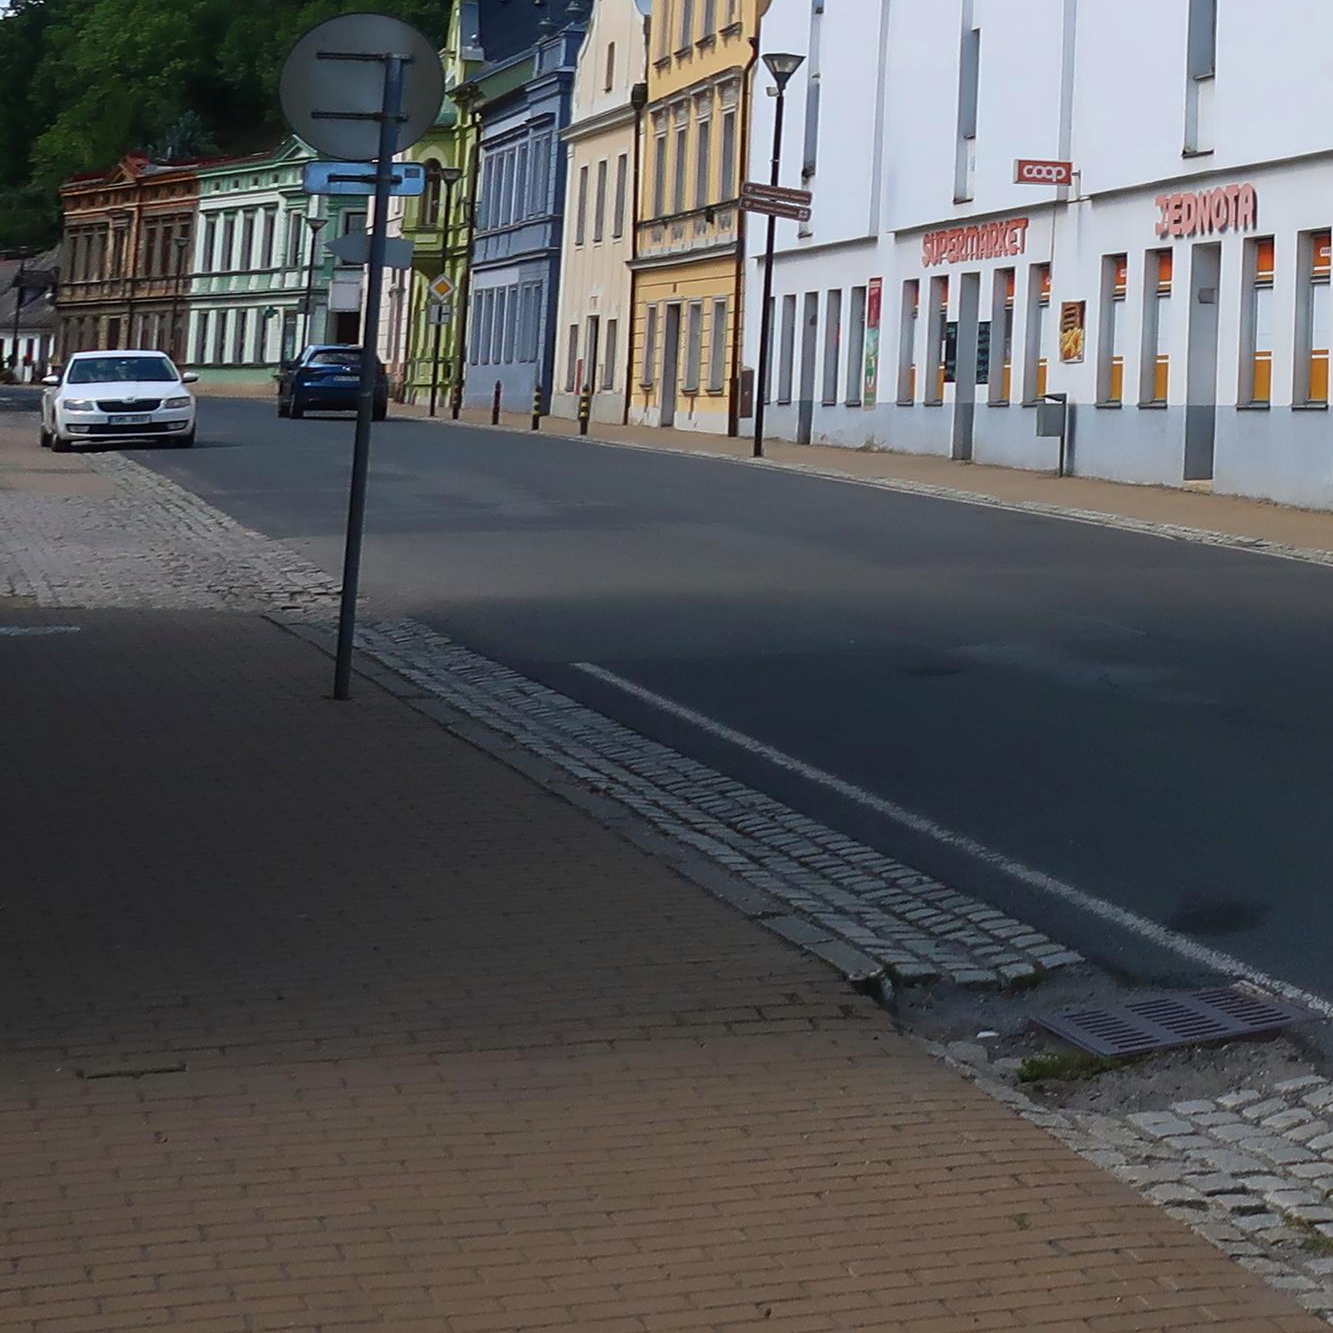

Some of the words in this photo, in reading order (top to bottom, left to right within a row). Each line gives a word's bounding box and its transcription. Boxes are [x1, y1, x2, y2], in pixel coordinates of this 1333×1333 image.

[1023, 165, 1067, 182] coop
[1155, 183, 1257, 237] JEDNOTA
[921, 217, 1029, 267] SUPERMARKET
